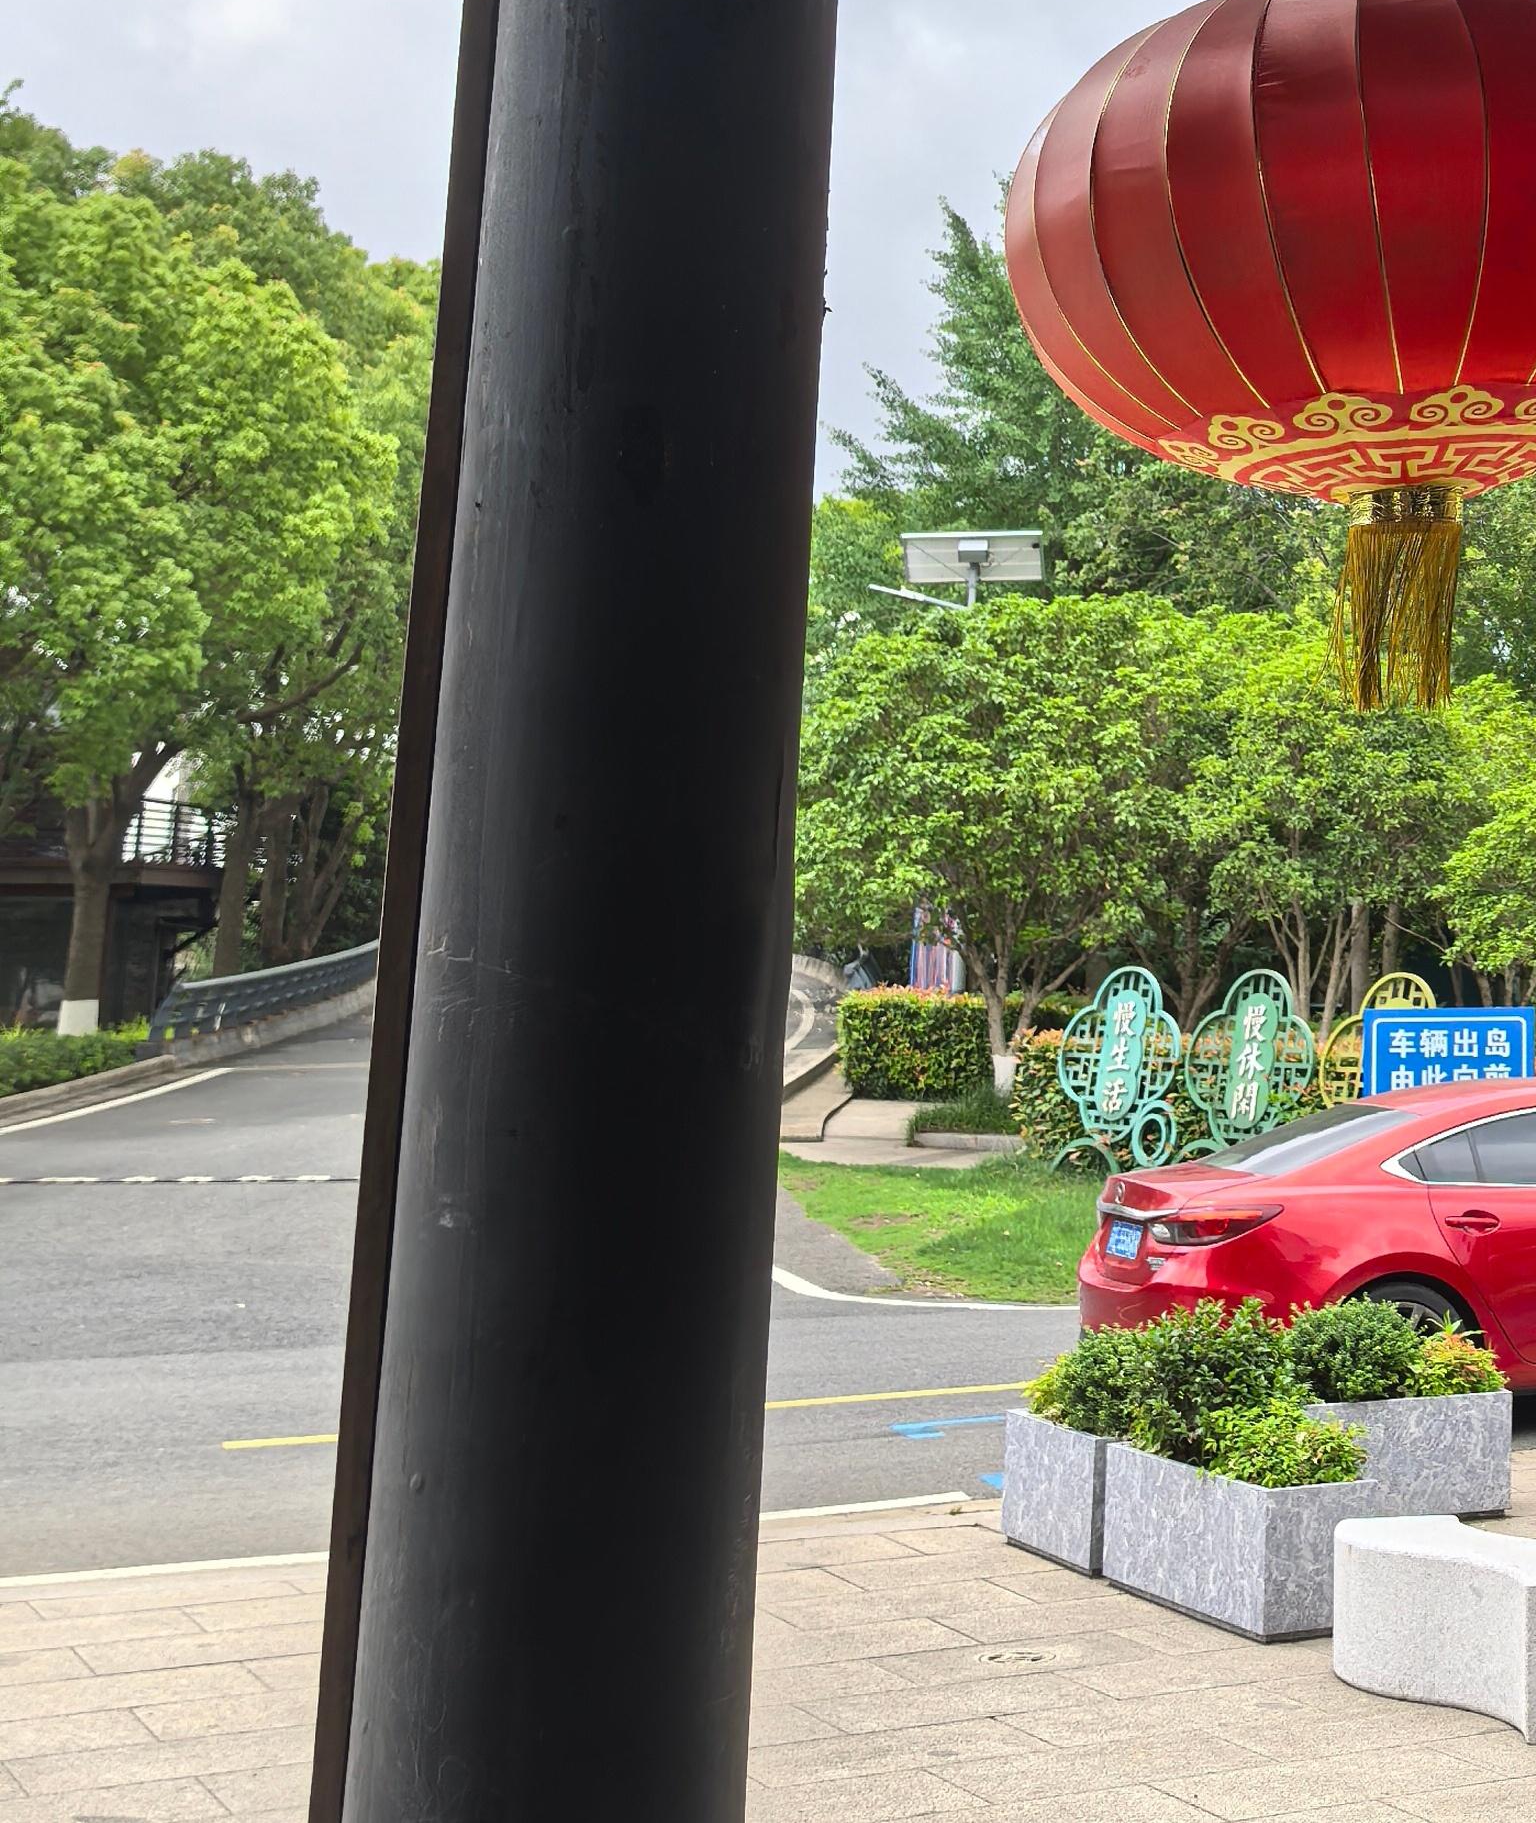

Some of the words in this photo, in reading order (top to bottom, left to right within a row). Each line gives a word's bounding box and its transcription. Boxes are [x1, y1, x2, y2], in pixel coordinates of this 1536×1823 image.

[1102, 1000, 1136, 1114] 慢生活
[1388, 1027, 1512, 1059] 车辆出岛
